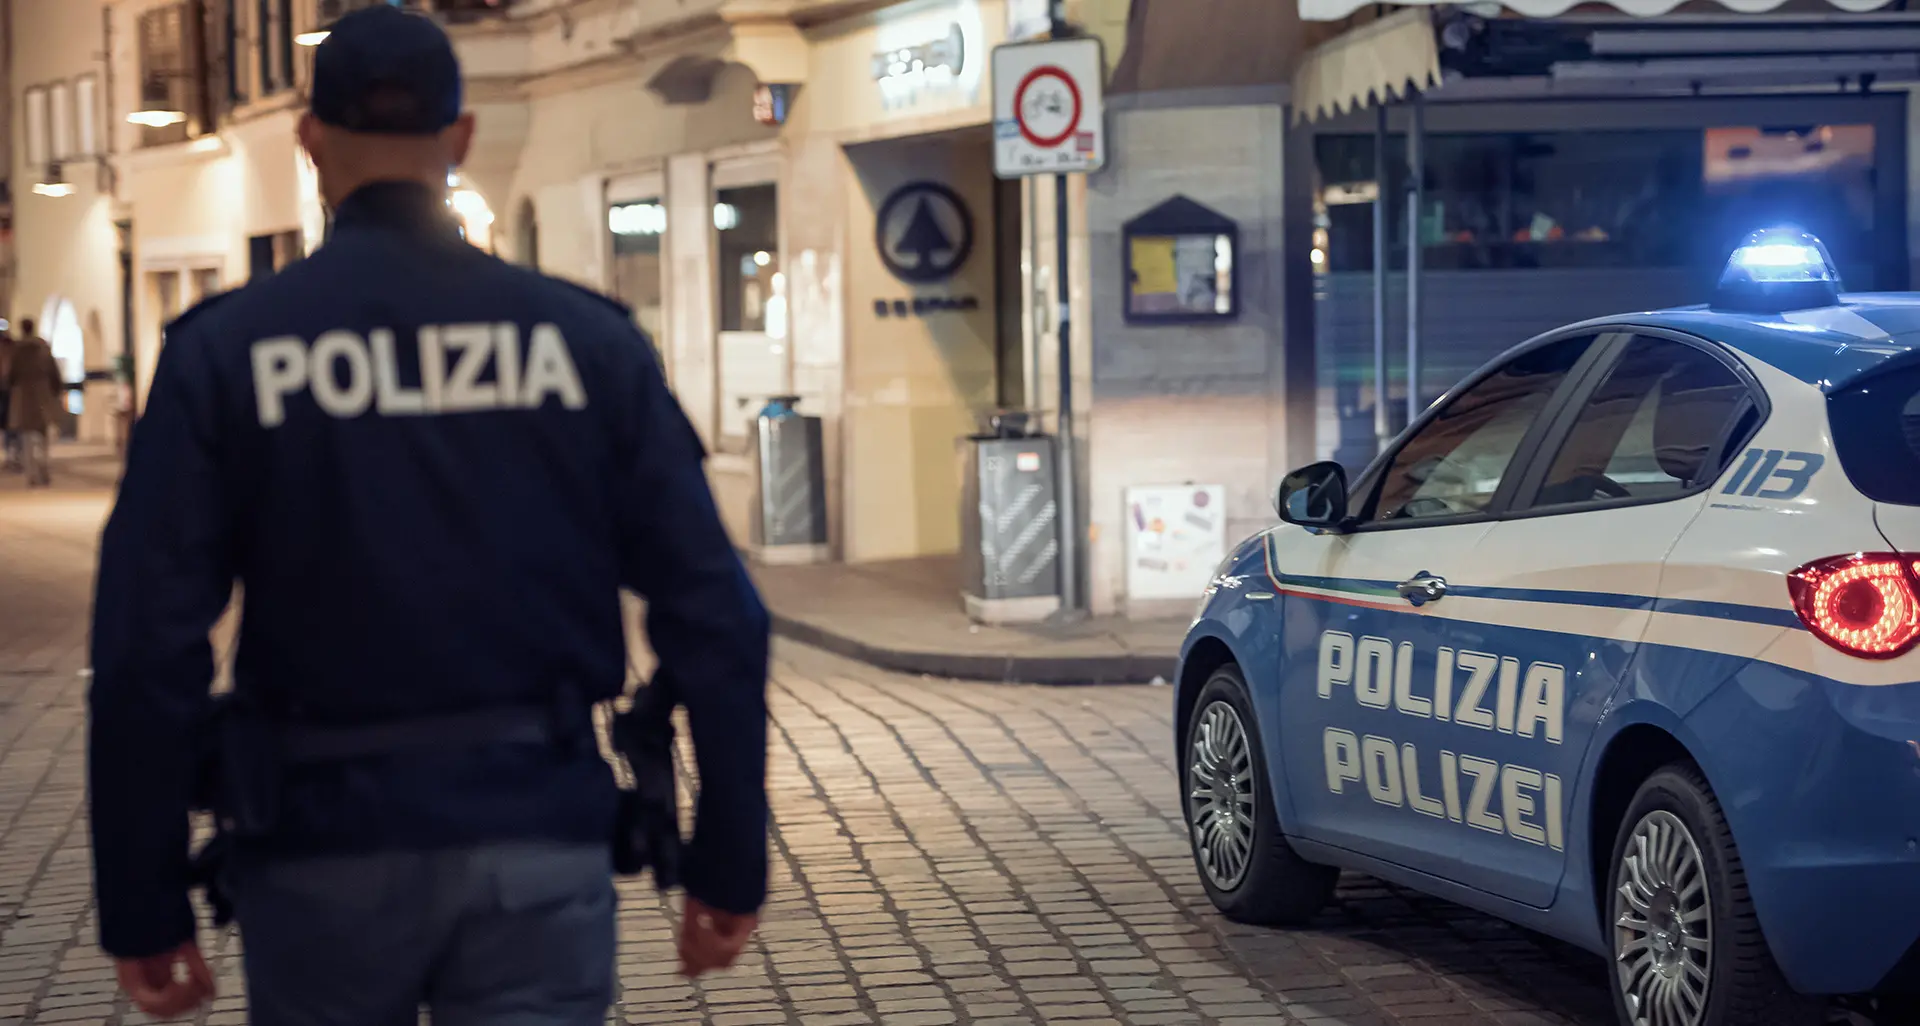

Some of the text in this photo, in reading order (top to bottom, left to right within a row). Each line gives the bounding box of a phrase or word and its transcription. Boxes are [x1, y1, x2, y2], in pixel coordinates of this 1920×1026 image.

[251, 321, 588, 428] POLIZIA
[1720, 448, 1825, 500] 113
[1316, 630, 1566, 745] POLIZIA
[1323, 727, 1564, 852] POLIZEI
